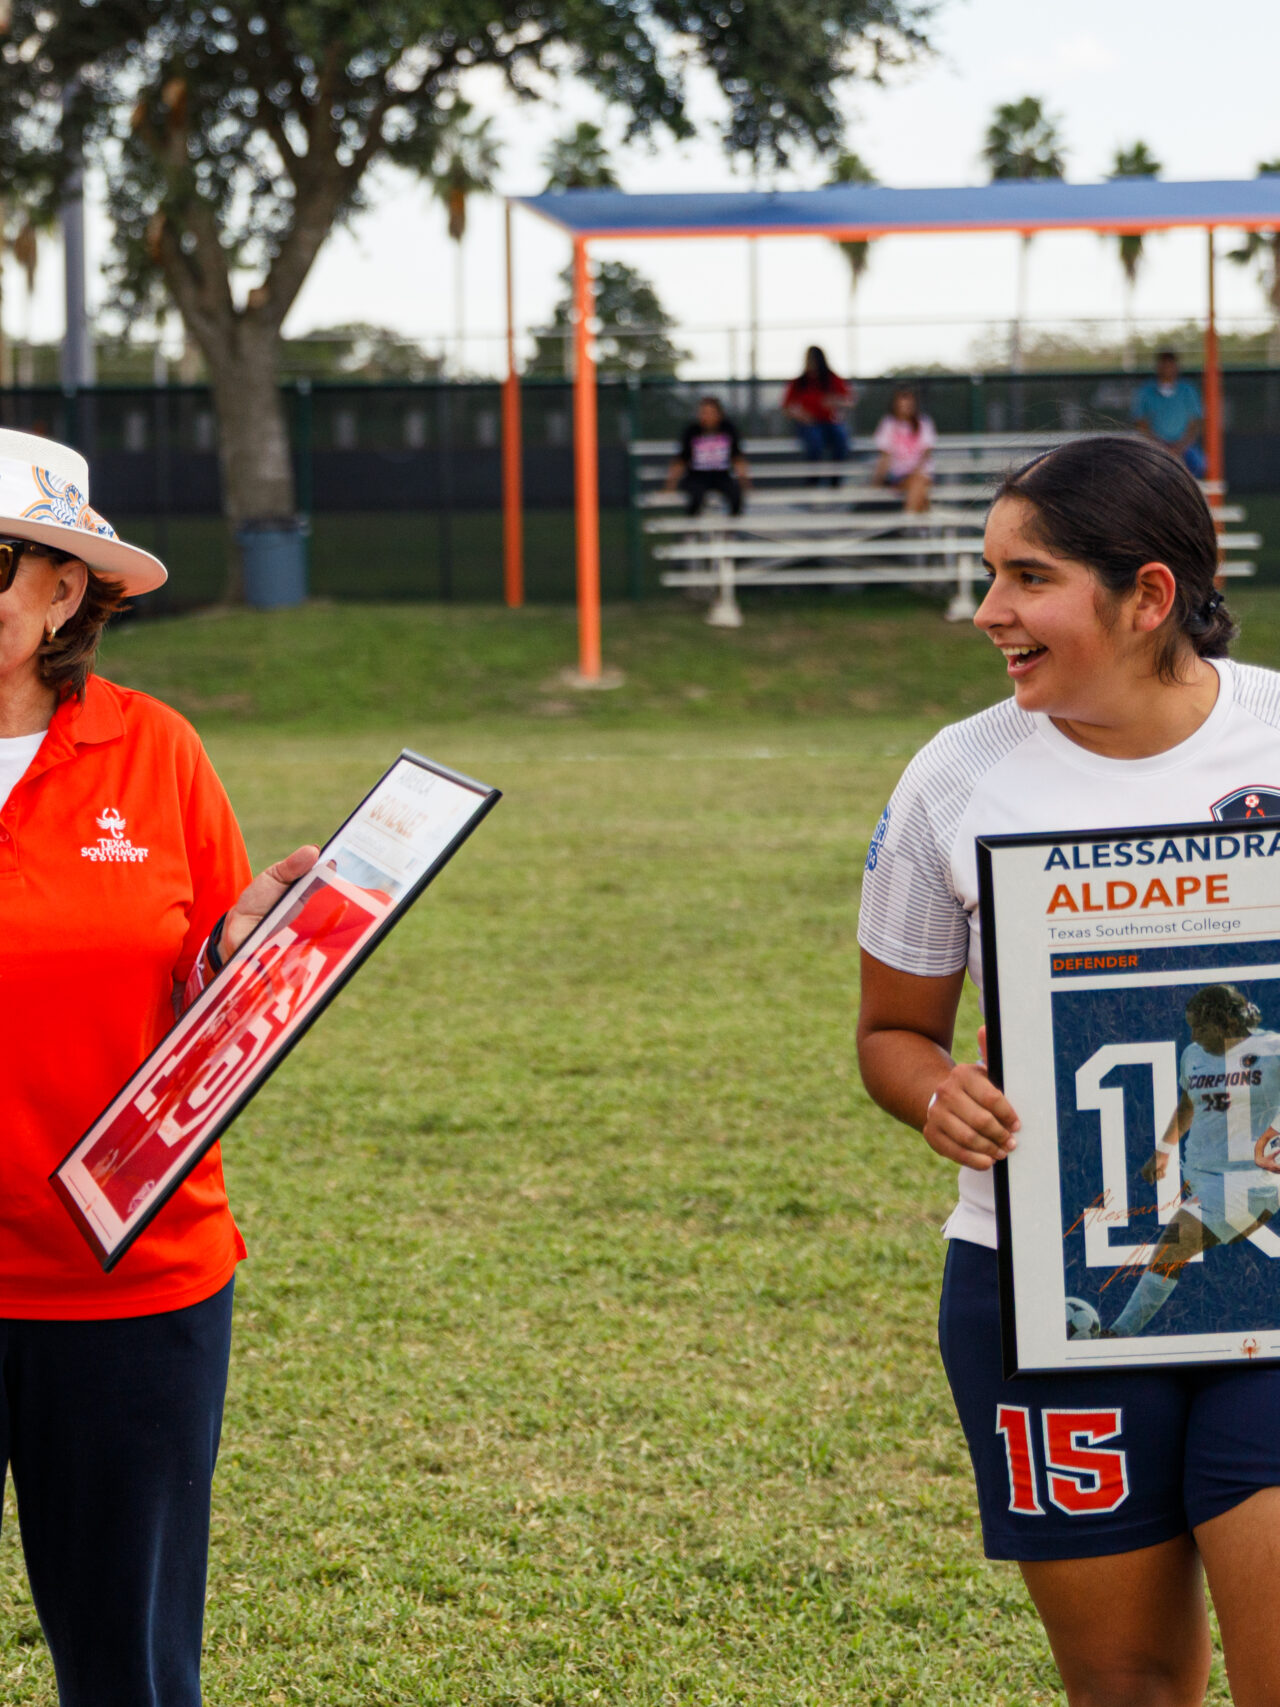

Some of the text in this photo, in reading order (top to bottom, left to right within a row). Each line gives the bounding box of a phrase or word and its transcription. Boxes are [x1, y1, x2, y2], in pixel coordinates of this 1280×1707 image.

[81, 847, 149, 857] SOUTHMOST
[97, 838, 132, 849] TEXAS
[1045, 873, 1230, 915] ALDAPE
[1048, 917, 1241, 940] Texas Southmost College
[1052, 955, 1138, 972] DEFENDER
[1187, 1069, 1263, 1091] CORPIONS
[996, 1404, 1130, 1517] 15
